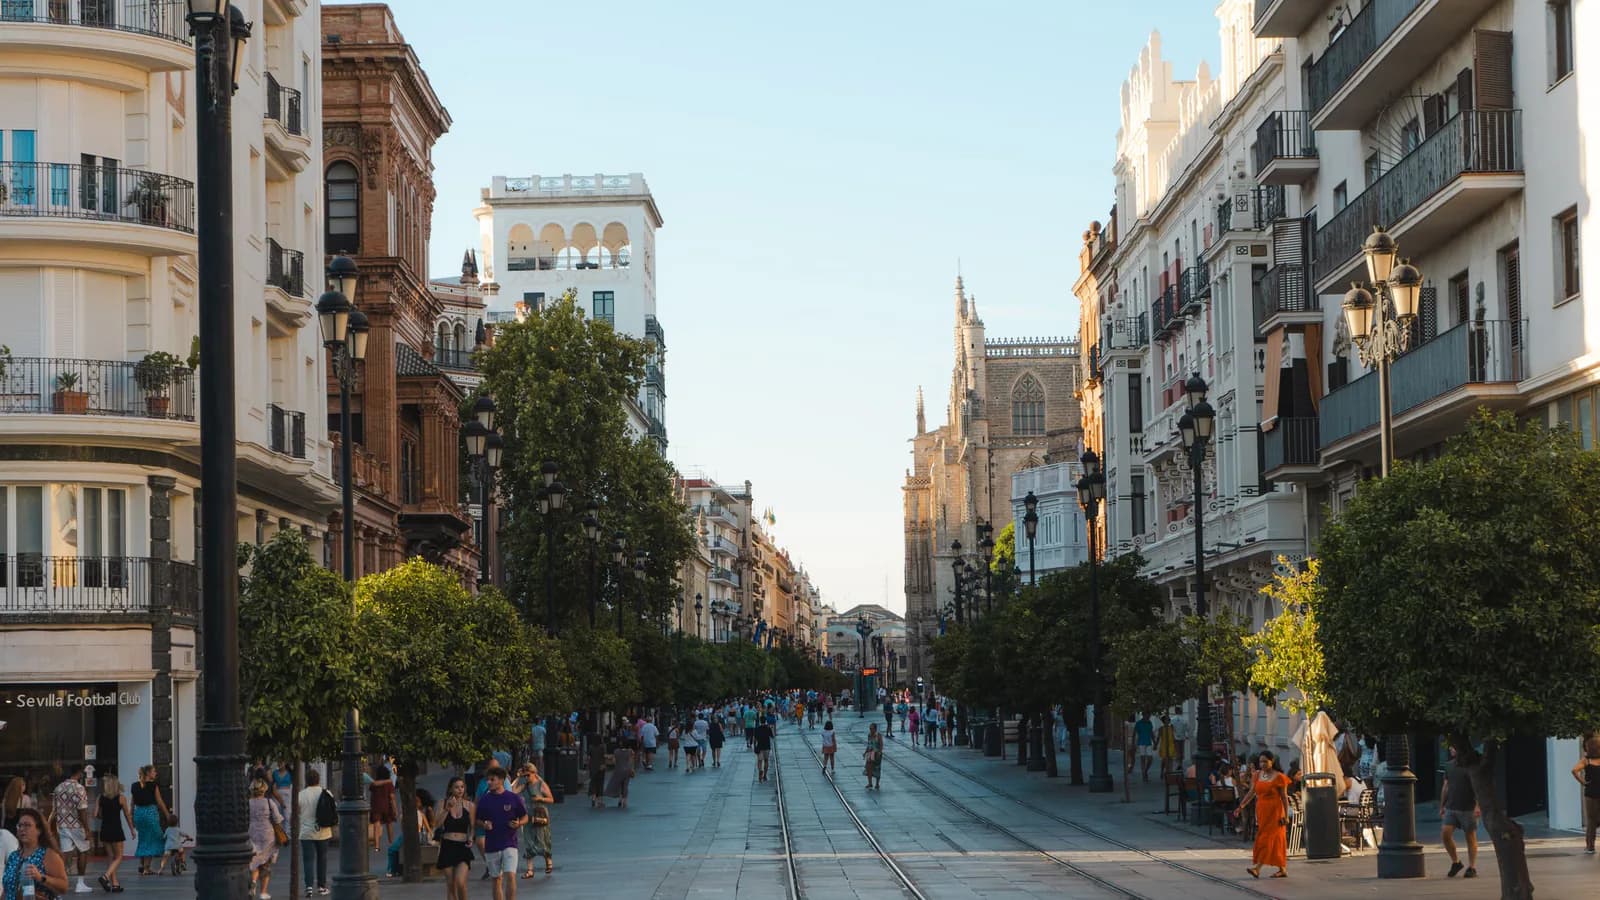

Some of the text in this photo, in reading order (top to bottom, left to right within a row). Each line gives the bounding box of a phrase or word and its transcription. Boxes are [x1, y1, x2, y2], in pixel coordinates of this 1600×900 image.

[16, 691, 141, 708] Sevilla Football Club
